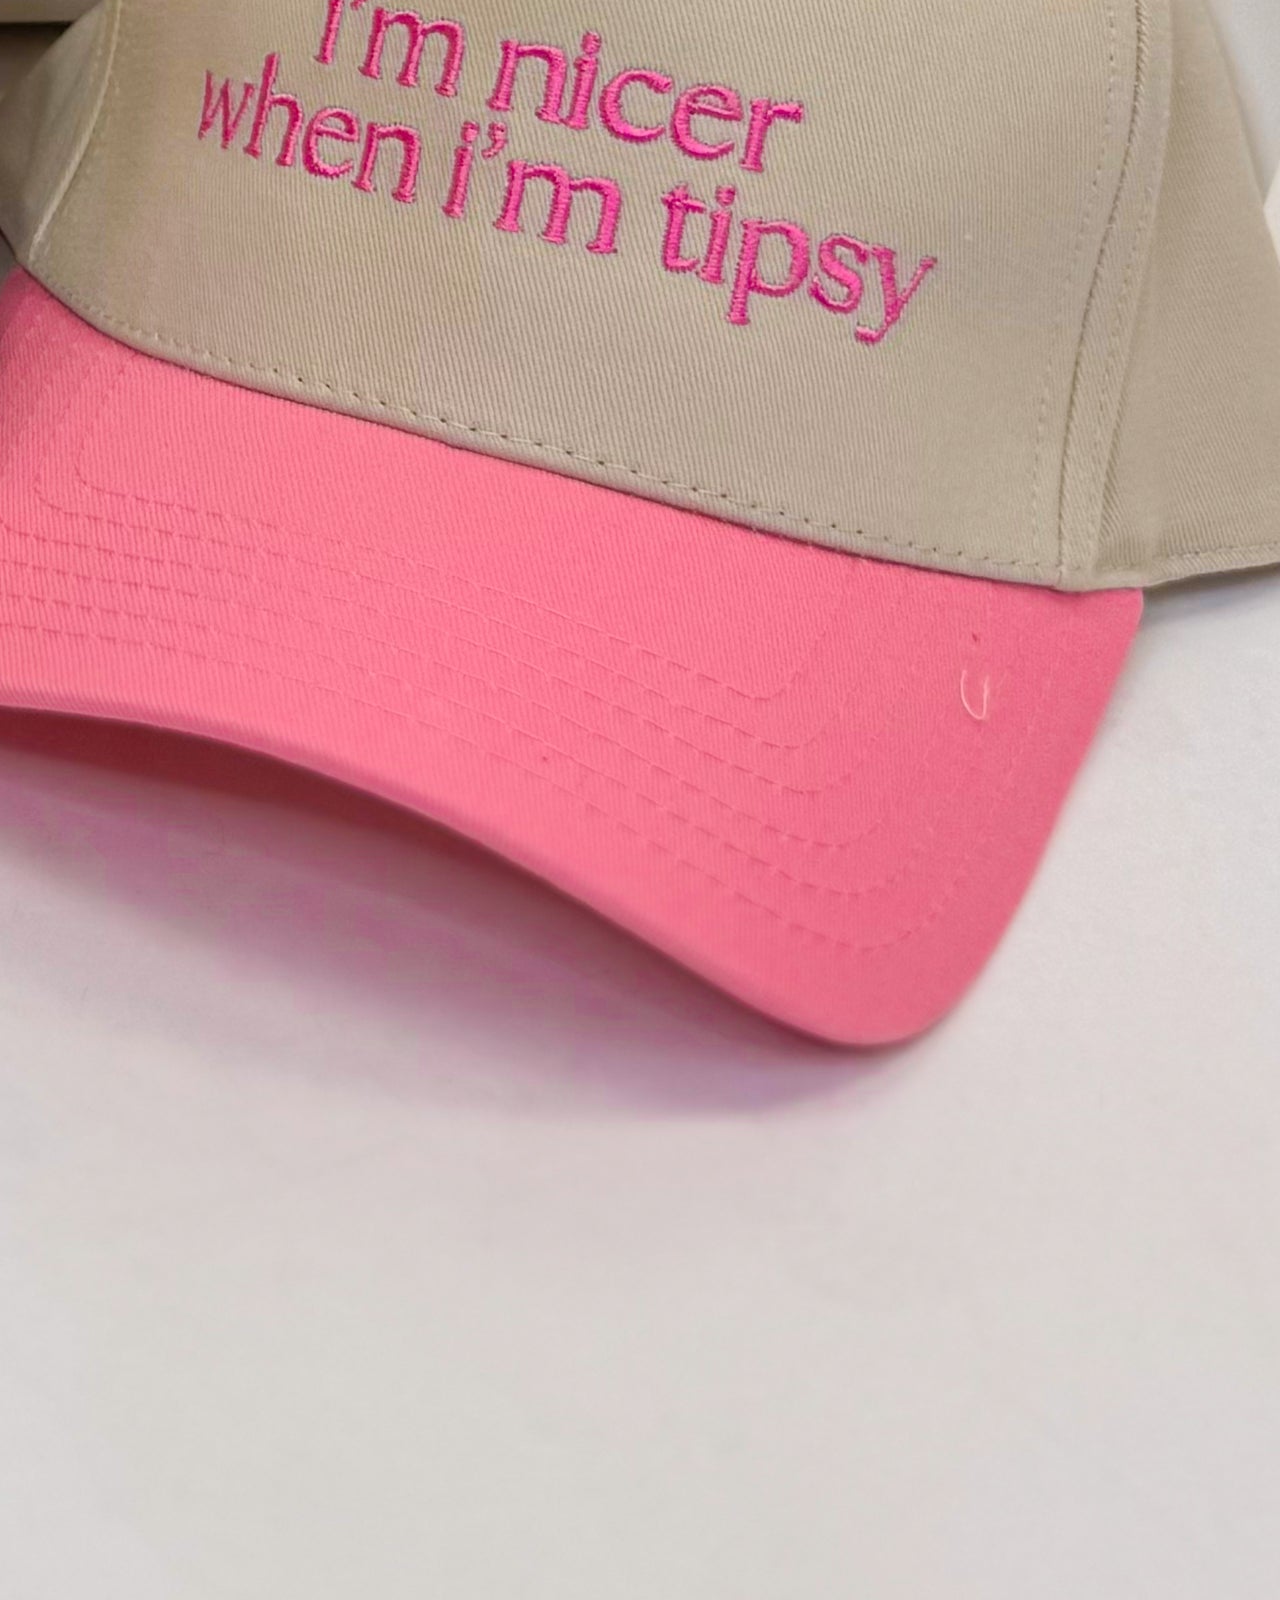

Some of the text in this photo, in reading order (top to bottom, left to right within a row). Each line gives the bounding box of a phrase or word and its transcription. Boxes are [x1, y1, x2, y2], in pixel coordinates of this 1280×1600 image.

[197, 52, 938, 346] when i'm tipsy
[487, 31, 804, 173] nicer
